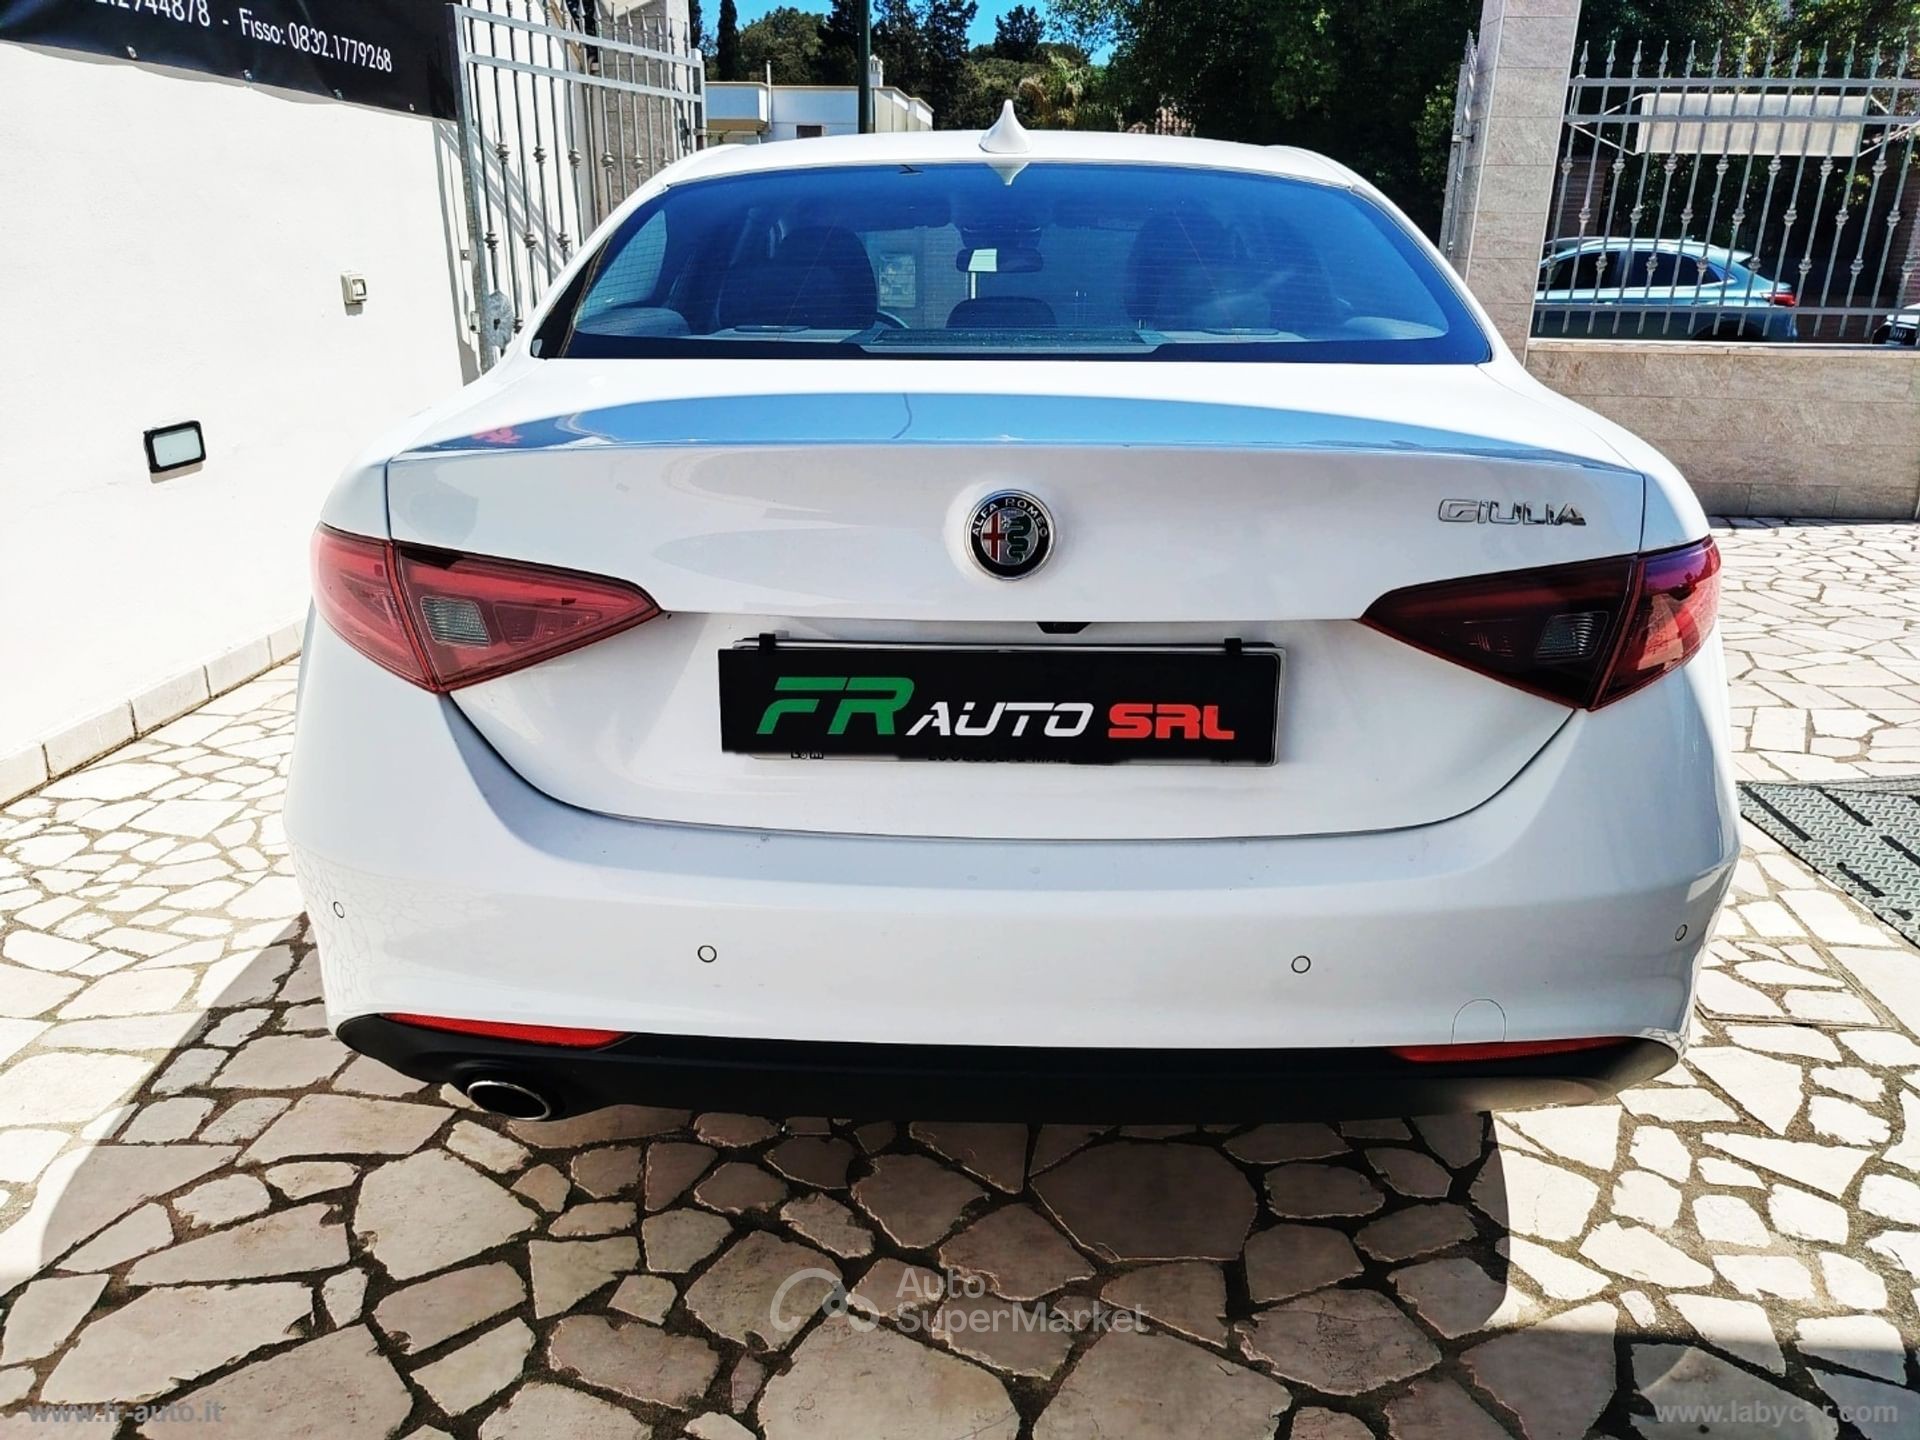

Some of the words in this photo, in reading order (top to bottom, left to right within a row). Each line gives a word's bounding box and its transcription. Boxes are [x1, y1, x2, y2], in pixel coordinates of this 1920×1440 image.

[239, 8, 287, 45] Fisso:
[288, 22, 392, 73] 0832.1779268
[972, 503, 999, 538] ALFA
[1005, 498, 1048, 538] ROMEO
[1438, 498, 1586, 526] GIULIA
[756, 677, 915, 734] FR
[906, 702, 1093, 736] AUTO
[1108, 703, 1235, 740] SRL
